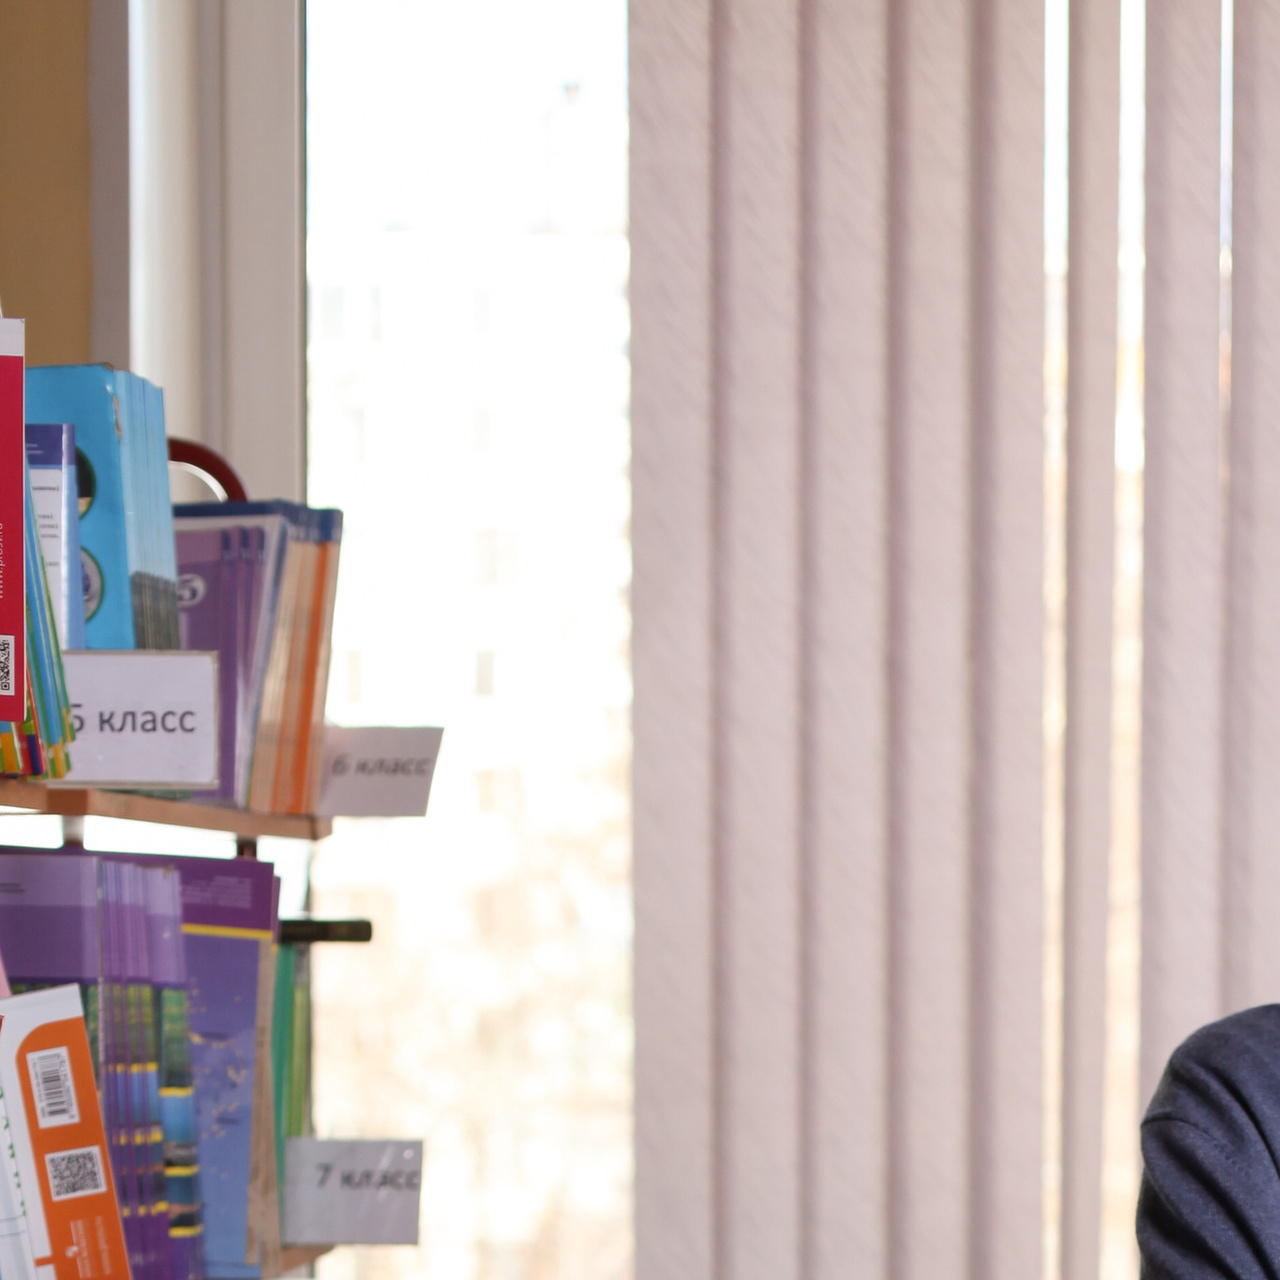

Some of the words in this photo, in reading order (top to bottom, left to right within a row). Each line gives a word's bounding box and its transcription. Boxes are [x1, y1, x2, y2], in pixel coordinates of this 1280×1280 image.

[98, 709, 196, 733] класс
[354, 757, 433, 777] класс
[315, 1162, 333, 1190] 7
[340, 1168, 420, 1191] класс
